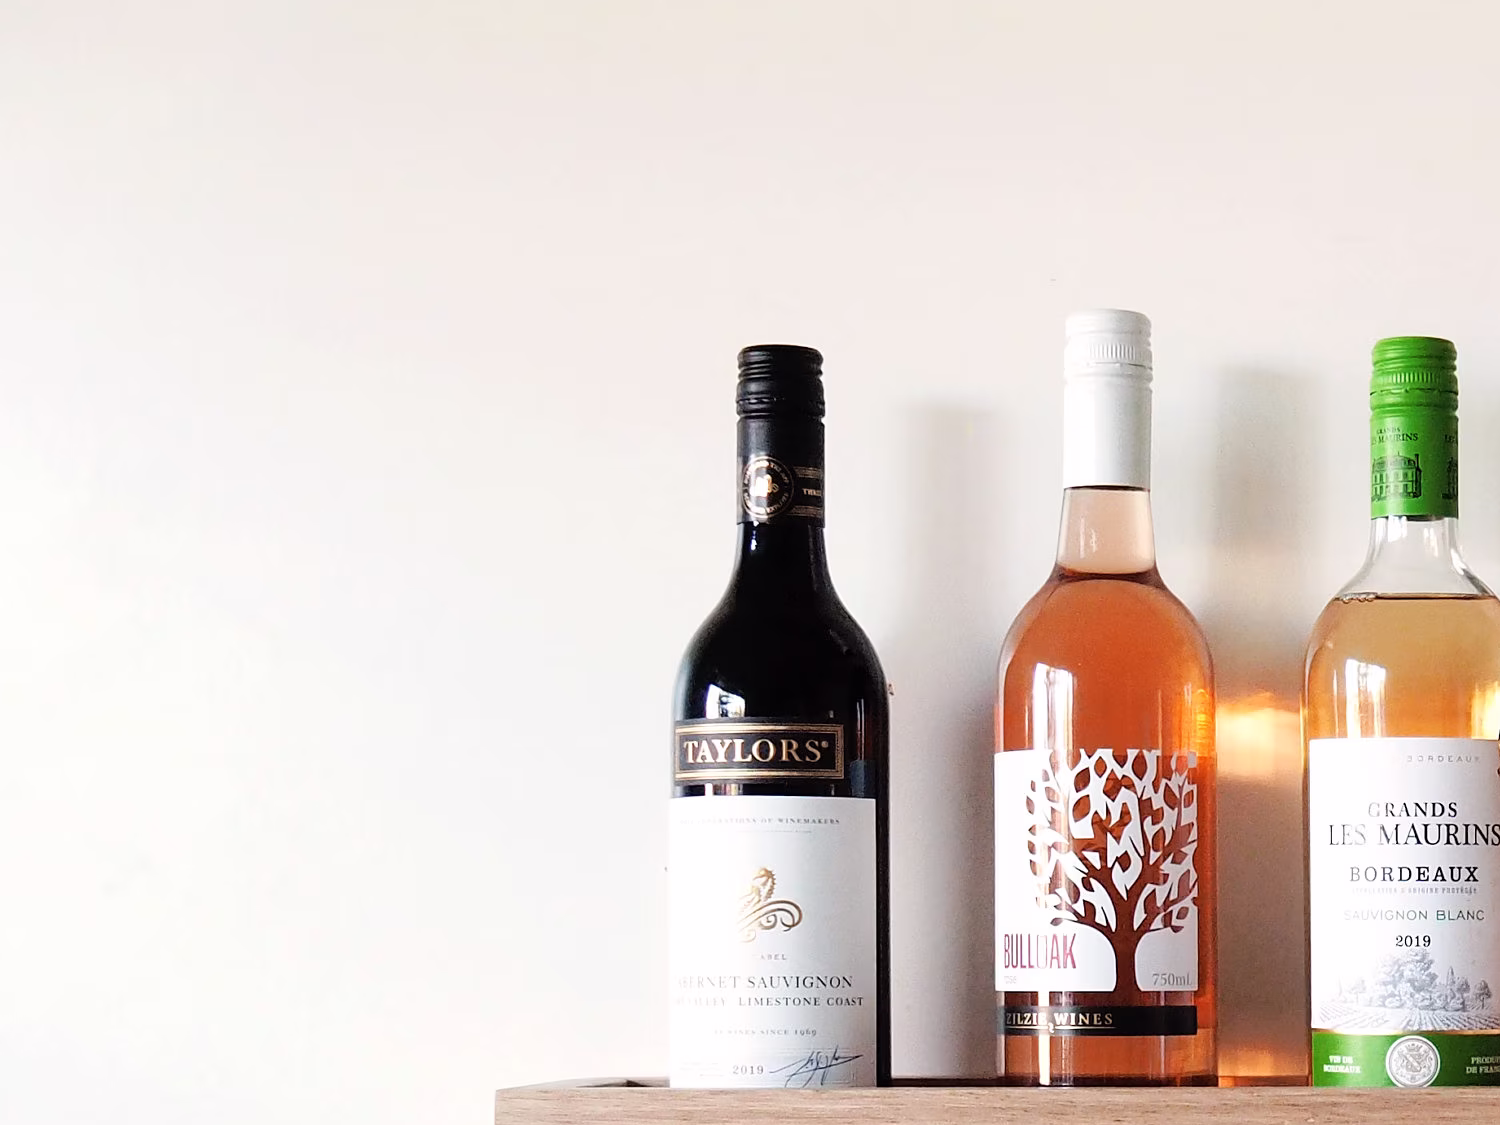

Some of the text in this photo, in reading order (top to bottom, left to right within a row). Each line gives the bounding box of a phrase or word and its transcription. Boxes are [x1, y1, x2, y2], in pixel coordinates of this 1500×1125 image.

[1368, 802, 1458, 817] GRANDS
[1329, 824, 1366, 846] LES
[1350, 867, 1480, 882] BORDEAUX
[1344, 910, 1485, 921] SAUVIGNON BLANC
[1395, 935, 1431, 947] 2019
[747, 975, 854, 989] SAUVIGNON
[739, 997, 821, 1007] LIMESTONE
[826, 997, 864, 1007] COAST
[1054, 1012, 1113, 1025] WINES
[732, 1064, 764, 1074] 2019
[1466, 1066, 1478, 1074] DE
